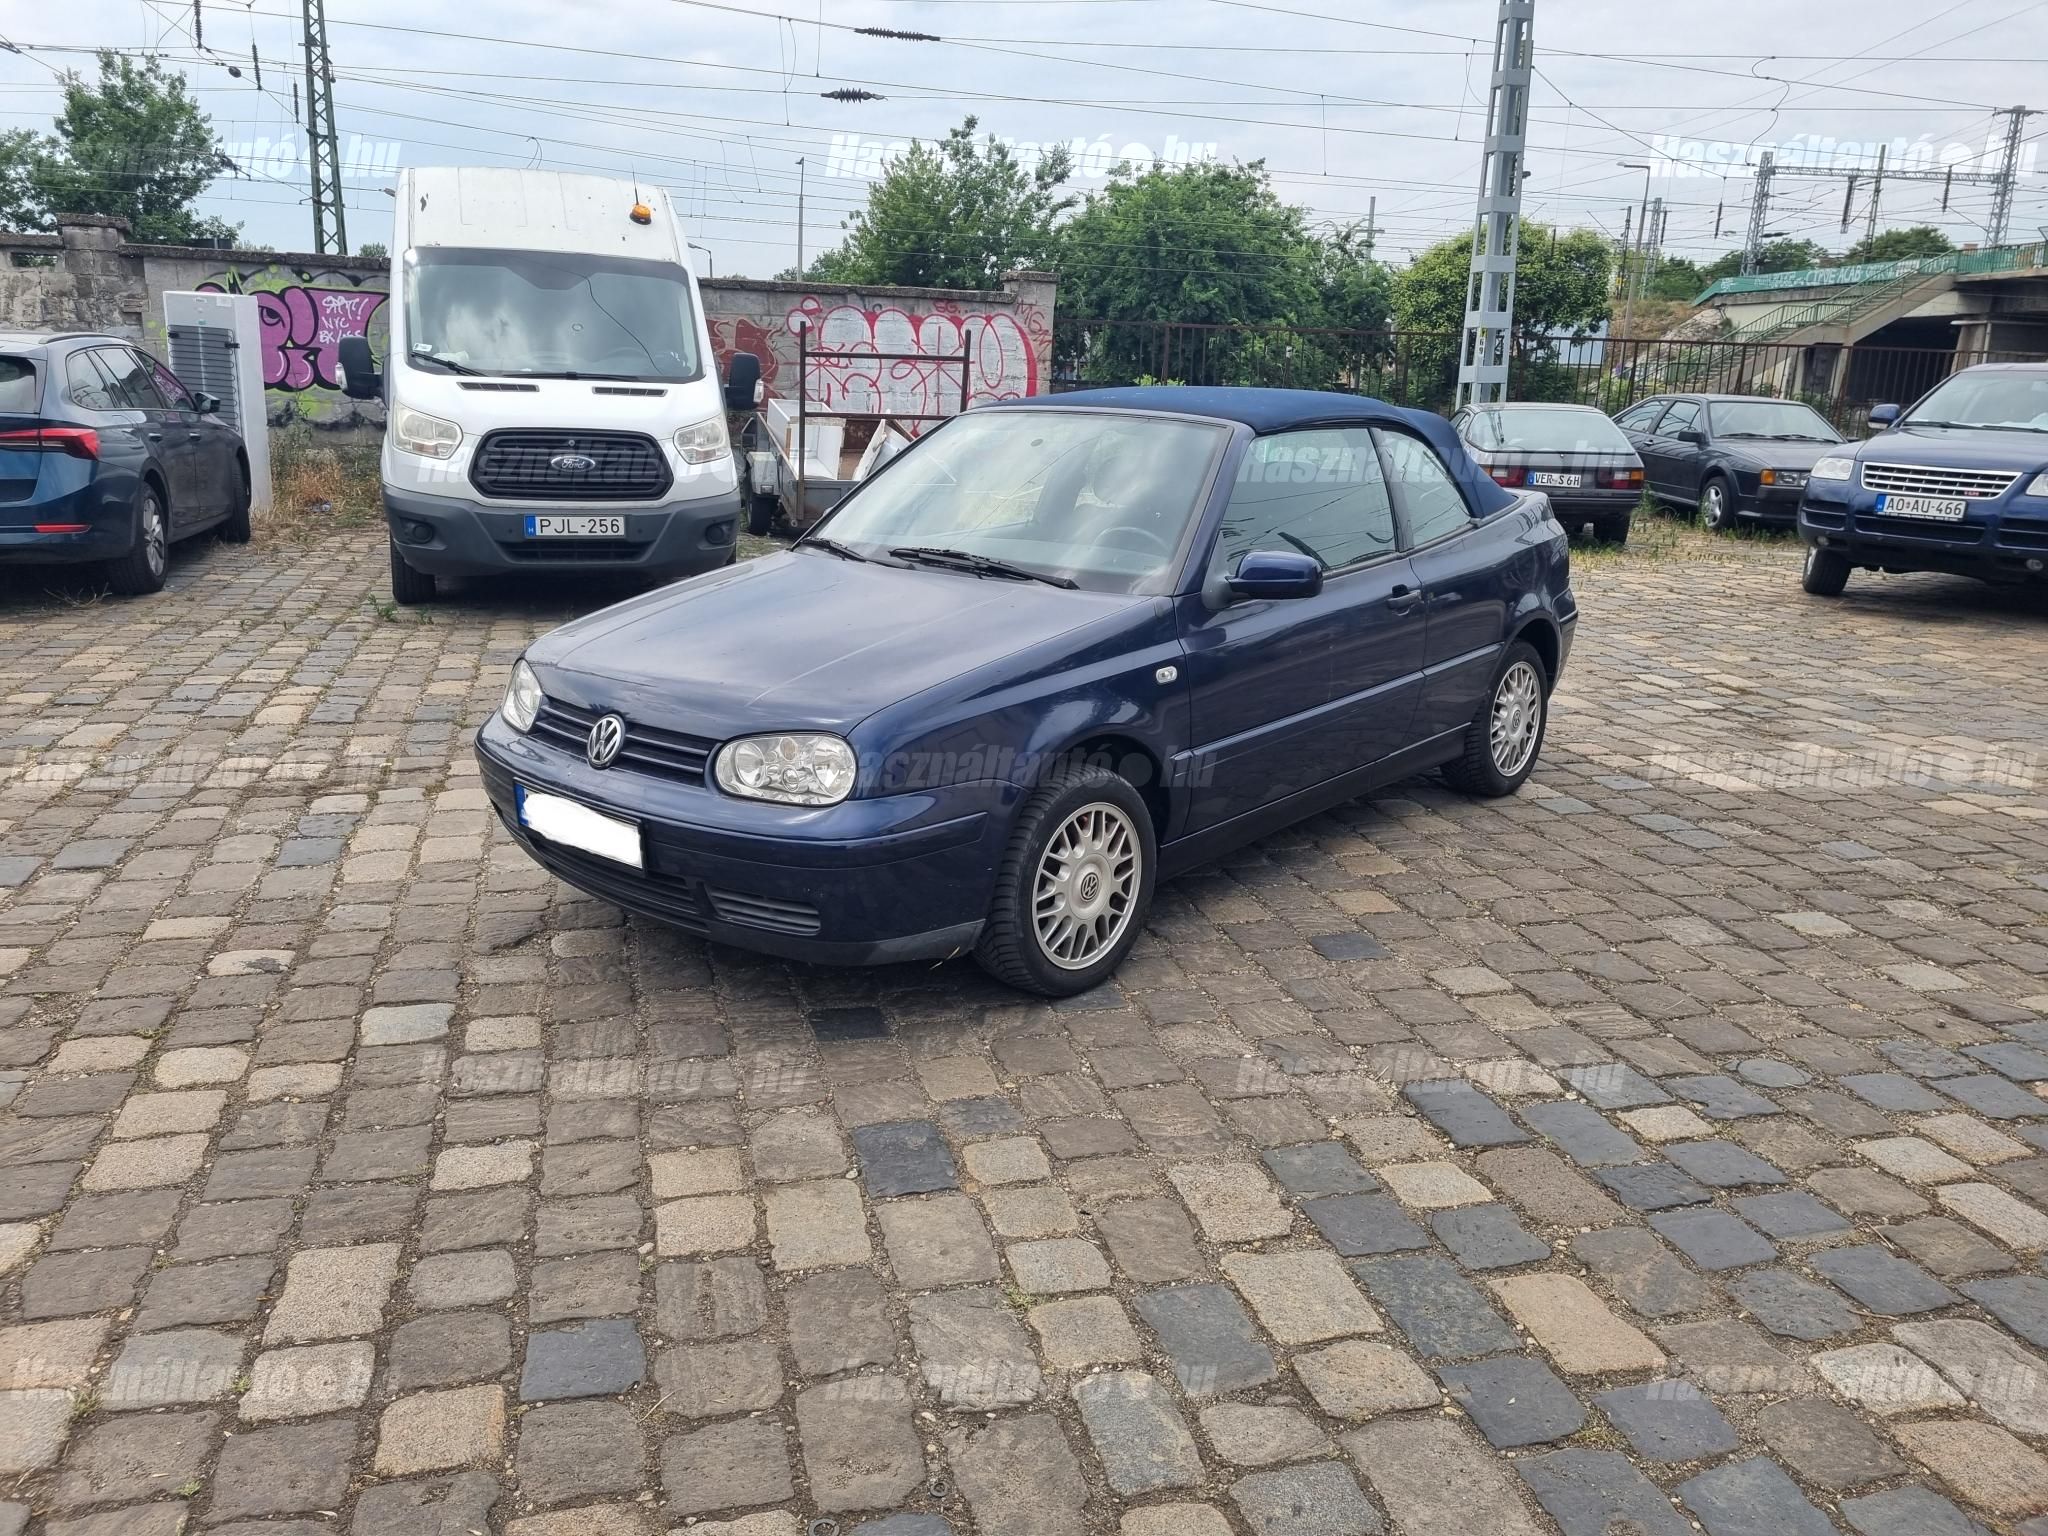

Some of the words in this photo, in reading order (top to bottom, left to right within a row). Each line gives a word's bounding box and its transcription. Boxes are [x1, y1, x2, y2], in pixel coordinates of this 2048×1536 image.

[321, 317, 350, 330] NYC
[560, 458, 586, 470] Ford
[1535, 473, 1553, 485] VER
[539, 518, 621, 535] PJL-256
